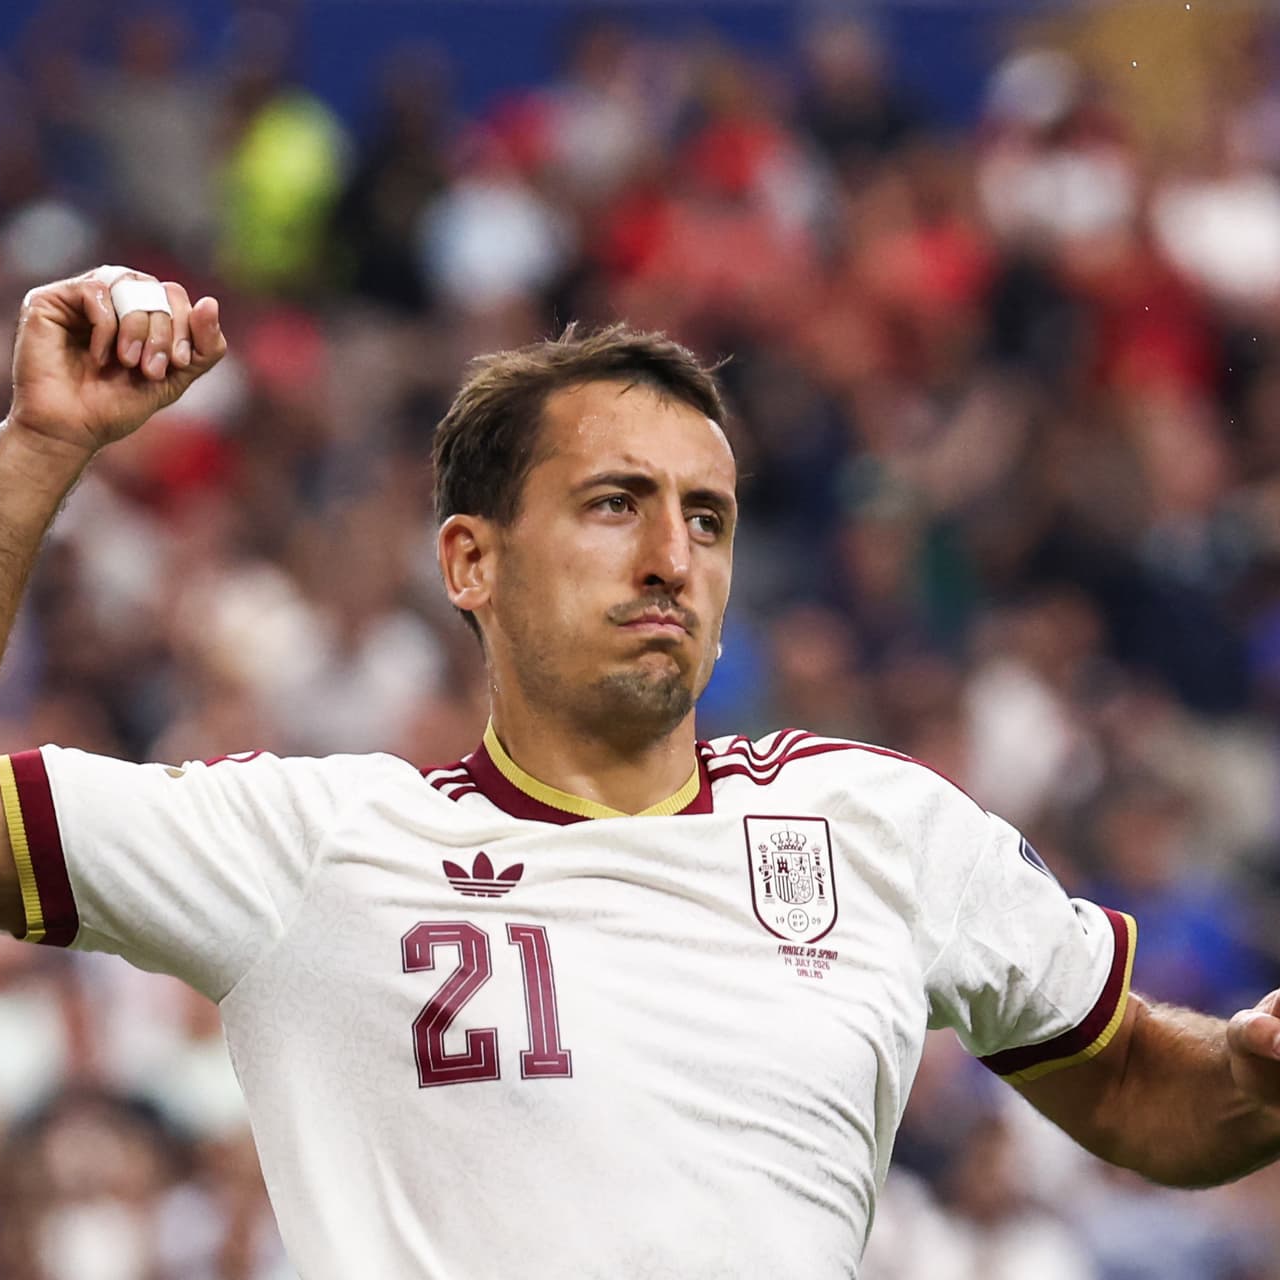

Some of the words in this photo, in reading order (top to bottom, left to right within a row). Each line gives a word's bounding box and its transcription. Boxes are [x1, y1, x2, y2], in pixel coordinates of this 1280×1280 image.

[777, 945, 805, 956] FRANCE
[806, 948, 817, 957] VS
[817, 949, 838, 960] SPAIN
[784, 956, 792, 965] 14
[795, 957, 810, 967] JULY
[813, 959, 831, 970] 2026
[796, 968, 823, 979] DALLAS
[400, 920, 573, 1088] 21
